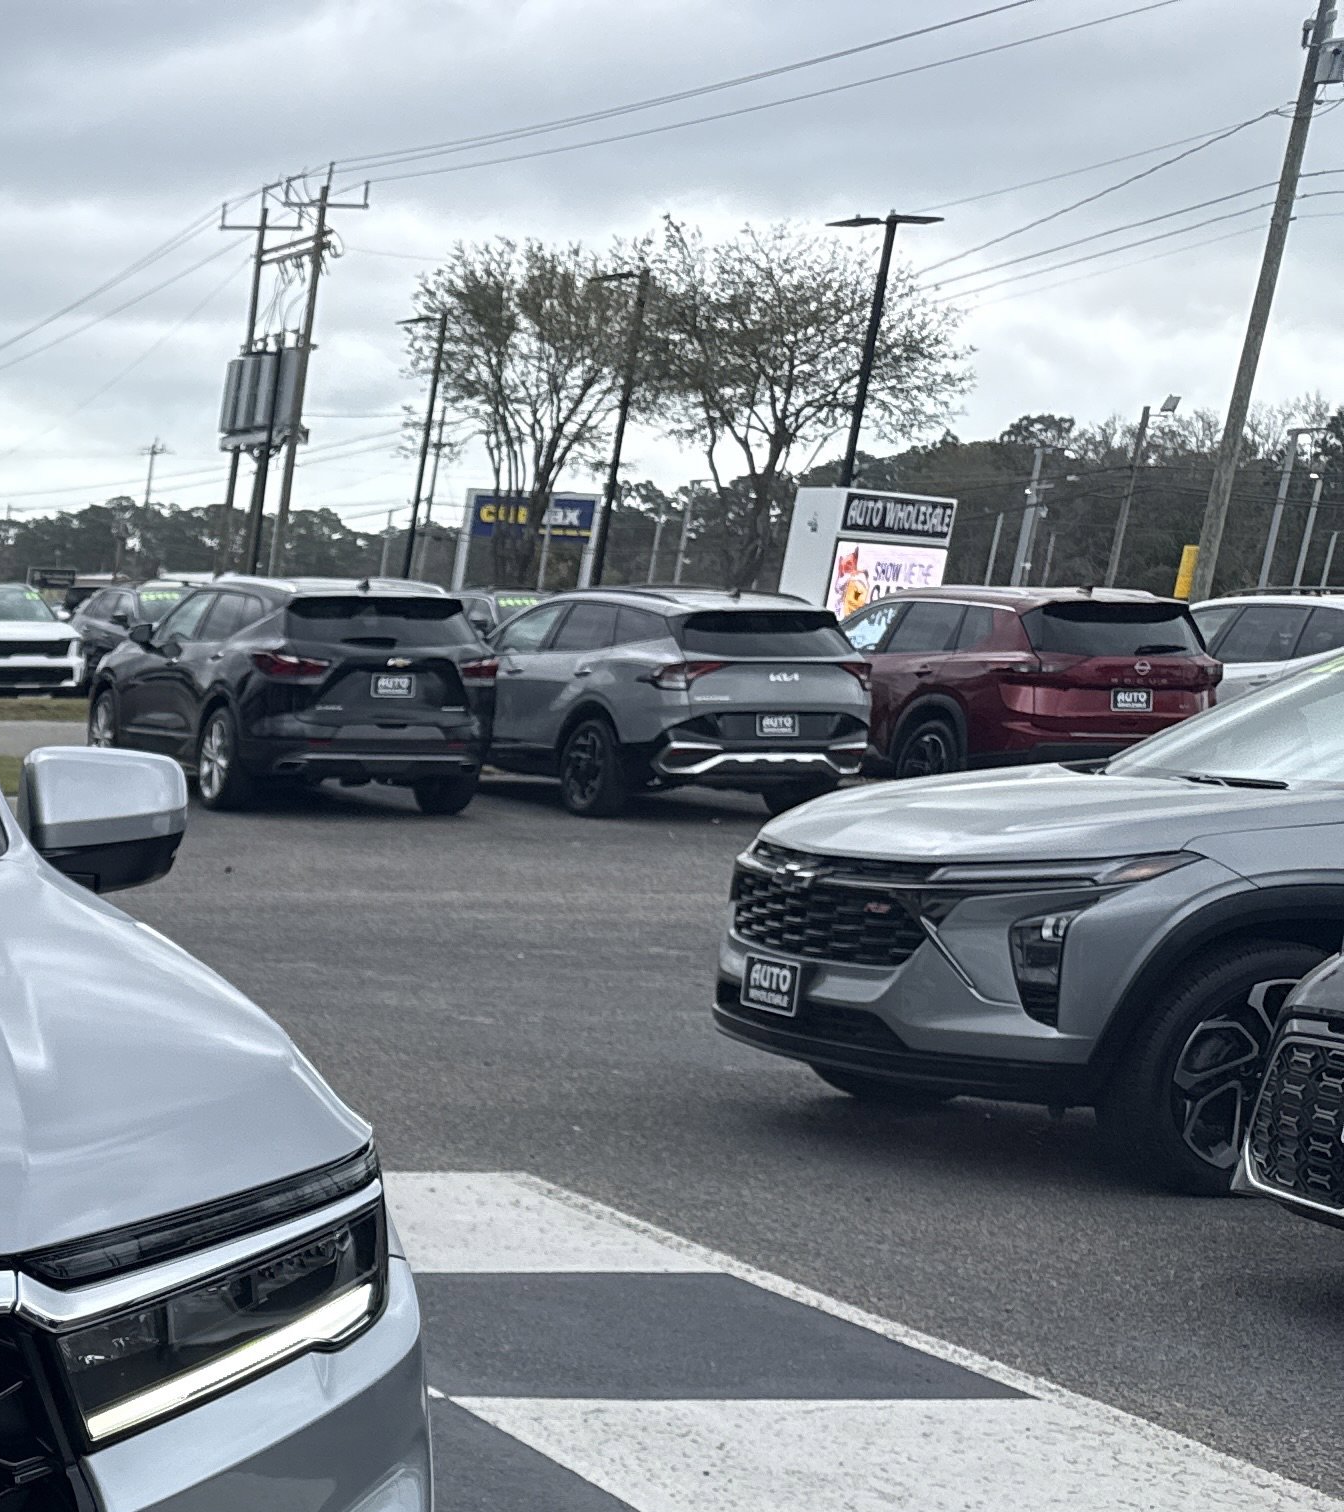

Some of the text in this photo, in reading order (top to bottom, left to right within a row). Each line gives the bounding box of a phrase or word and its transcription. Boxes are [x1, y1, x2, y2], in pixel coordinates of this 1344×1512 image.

[846, 499, 952, 534] AUTO WHOLESALE
[873, 562, 903, 583] SHOW
[1116, 691, 1148, 703] AUTO
[761, 715, 793, 728] AUTO
[749, 963, 792, 993] AUTO
